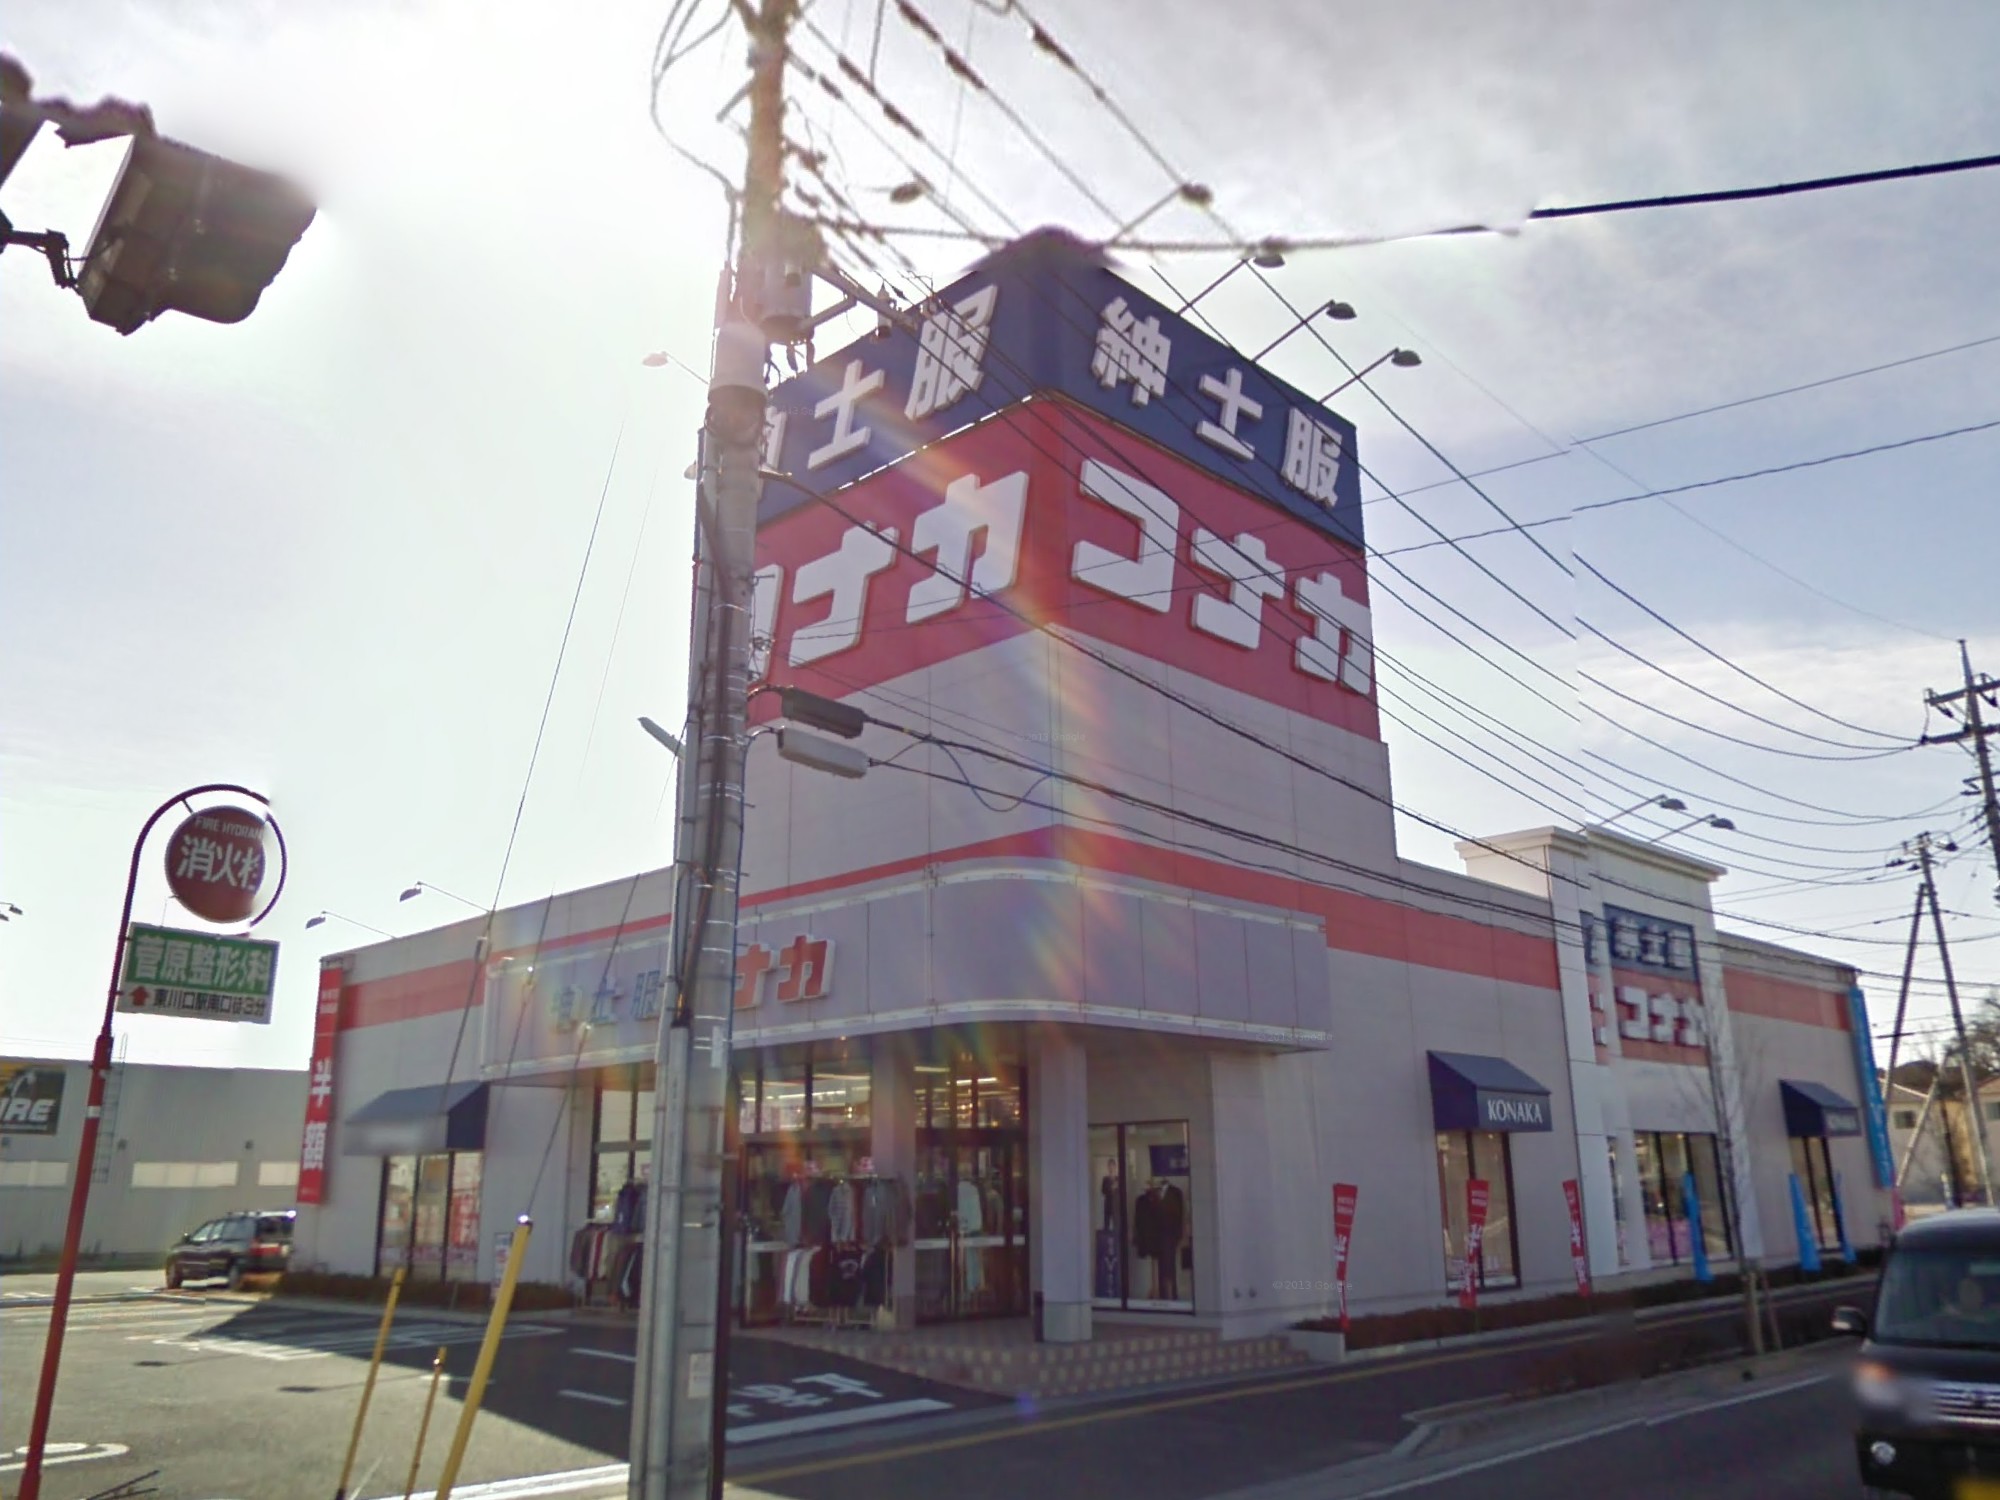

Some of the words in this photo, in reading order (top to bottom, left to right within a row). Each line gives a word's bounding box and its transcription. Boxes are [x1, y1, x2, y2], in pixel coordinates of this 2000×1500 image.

[1091, 297, 1343, 508] 紳士服
[1072, 458, 1372, 694] コナカ
[195, 816, 220, 832] FIRE
[1487, 1099, 1544, 1124] KONAKA
